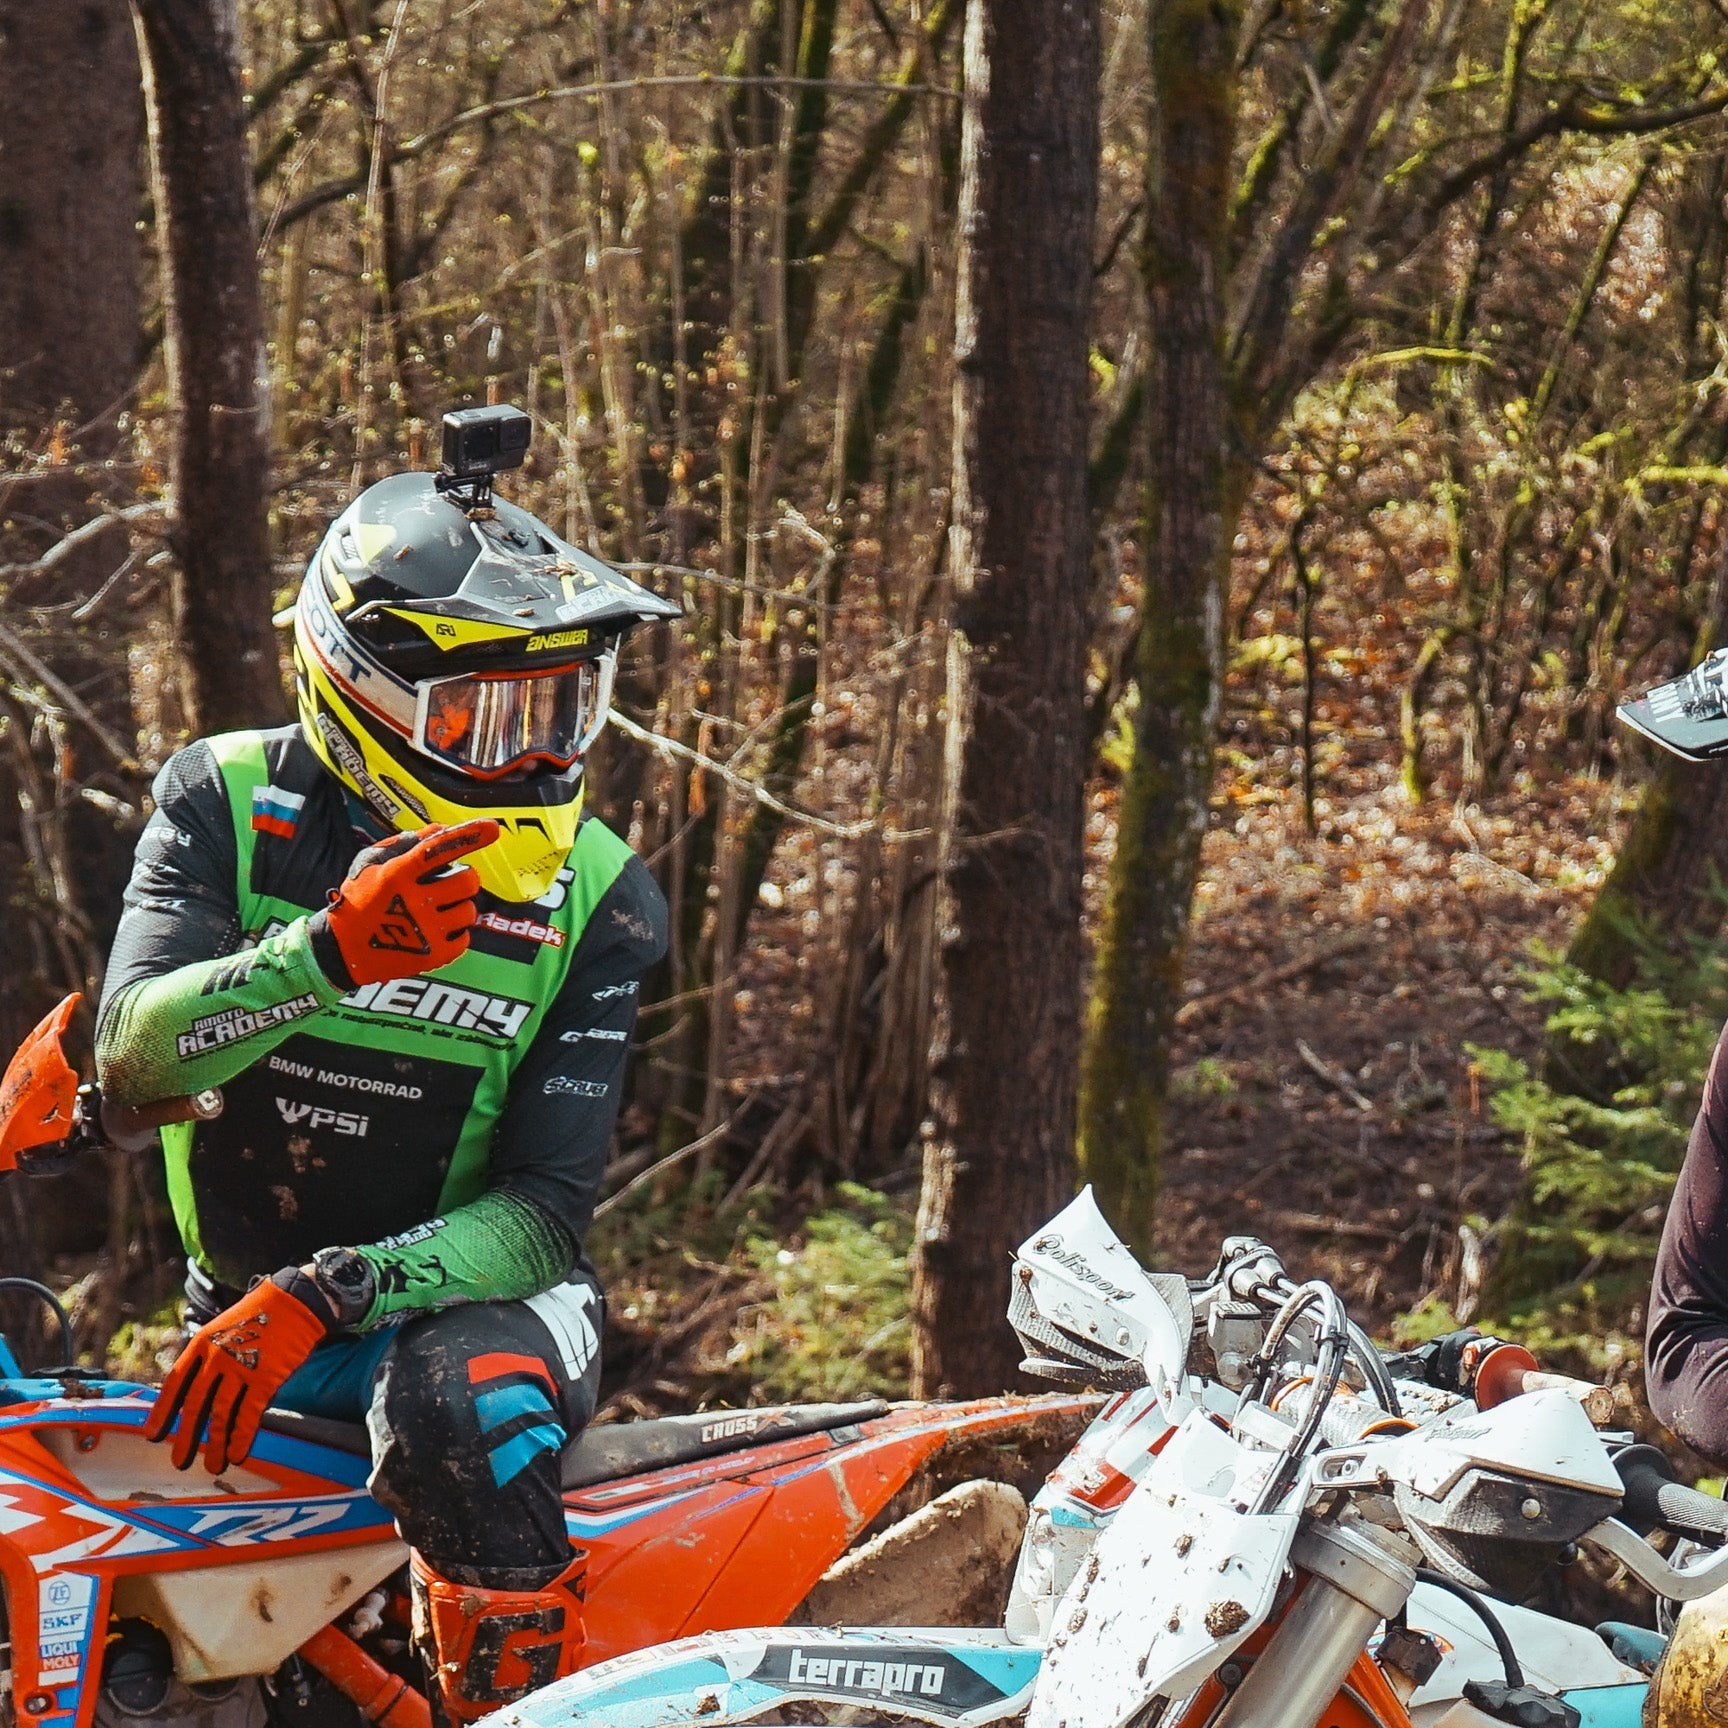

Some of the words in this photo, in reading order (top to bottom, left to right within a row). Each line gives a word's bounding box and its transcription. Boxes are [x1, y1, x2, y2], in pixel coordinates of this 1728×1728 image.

[177, 993, 319, 1056] ACADEMY
[269, 1055, 314, 1079] BMW
[317, 1069, 423, 1100] MOTORRAD
[43, 1613, 83, 1630] SKF
[41, 1640, 78, 1659] LIQUI
[43, 1653, 81, 1671] MOLY
[788, 1648, 946, 1695] terrapro
